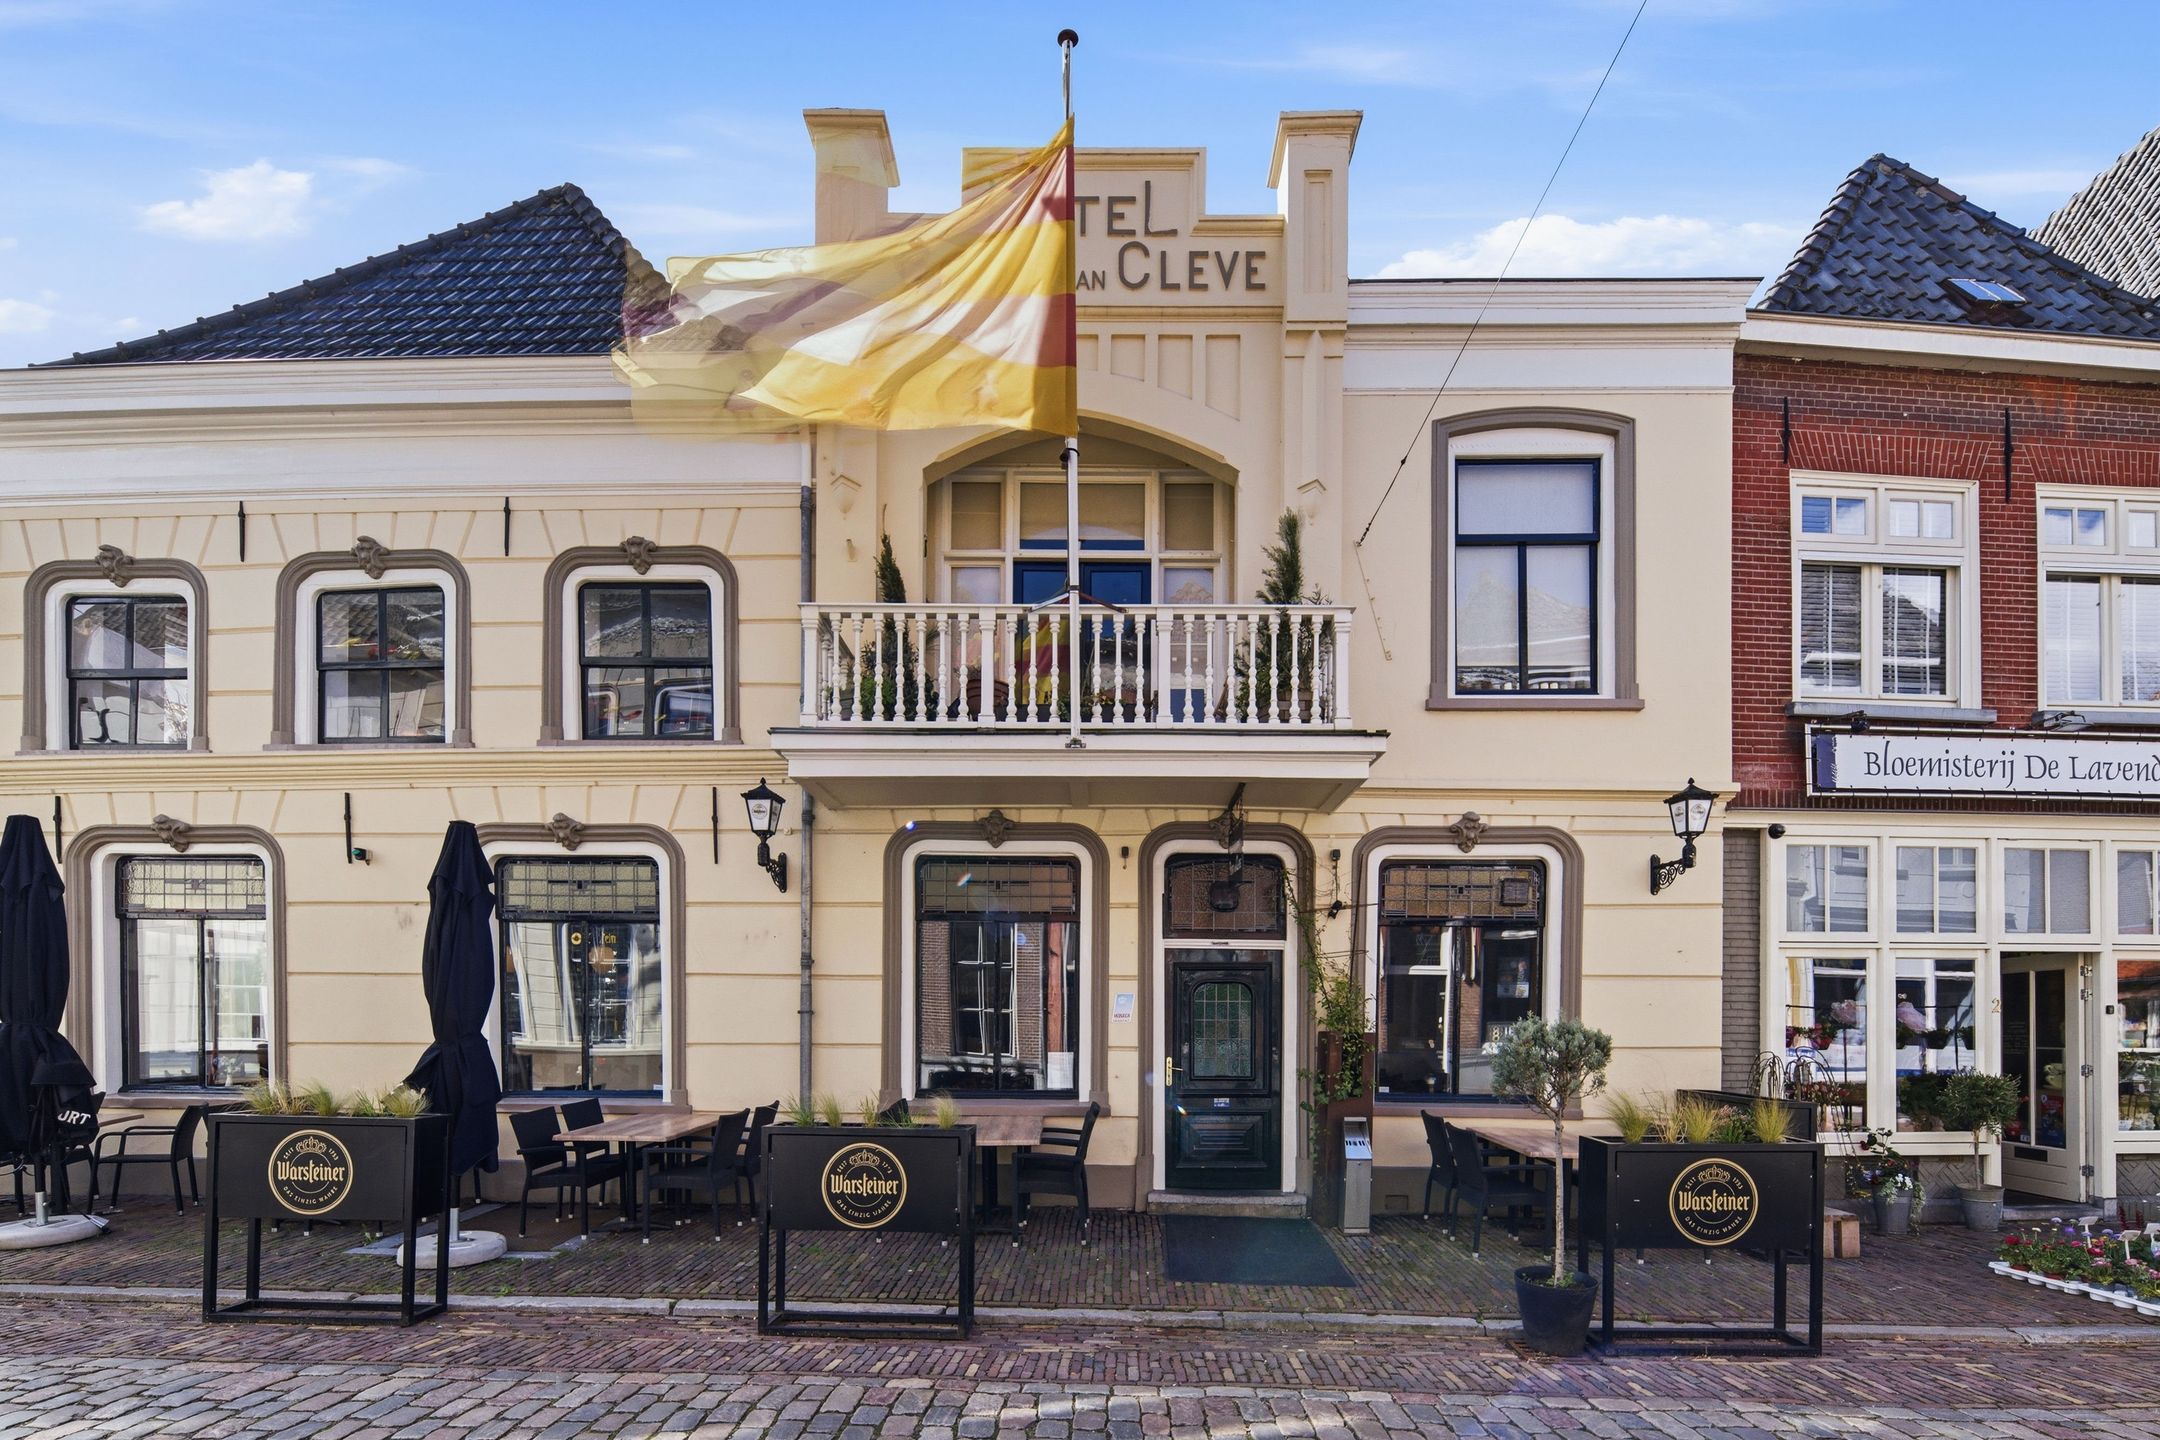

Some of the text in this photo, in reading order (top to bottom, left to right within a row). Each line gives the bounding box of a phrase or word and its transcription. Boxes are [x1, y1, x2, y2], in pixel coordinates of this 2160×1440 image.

[1073, 180, 1178, 237] TEL
[1076, 241, 1267, 291] AN CLEVE
[1863, 740, 2015, 789] Bloemisterij
[2023, 754, 2061, 779] De
[1991, 997, 2000, 1014] 2
[277, 1160, 345, 1183] Warsteiner
[830, 1173, 899, 1197] Warsteiner
[1678, 1189, 1751, 1213] Warsteiner
